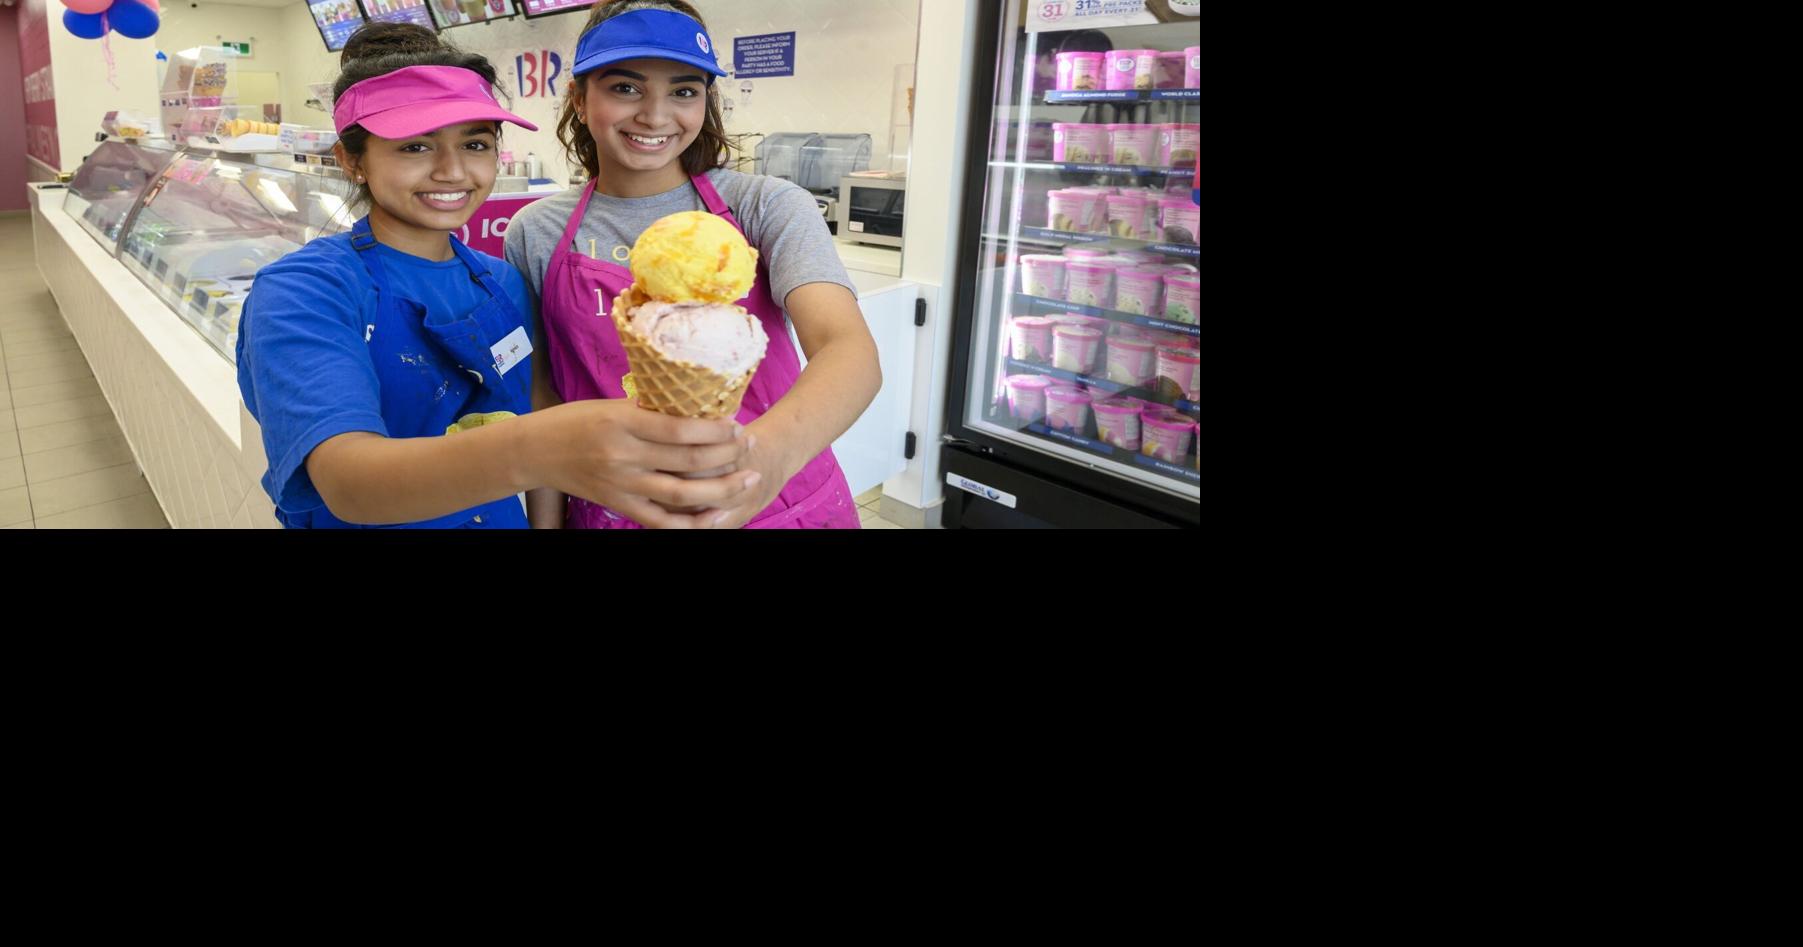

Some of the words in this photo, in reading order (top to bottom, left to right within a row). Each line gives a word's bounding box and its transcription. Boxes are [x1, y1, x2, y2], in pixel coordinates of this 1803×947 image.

[1042, 4, 1064, 17] 31
[515, 49, 562, 98] BR
[1154, 245, 1192, 253] CHOCOLATE
